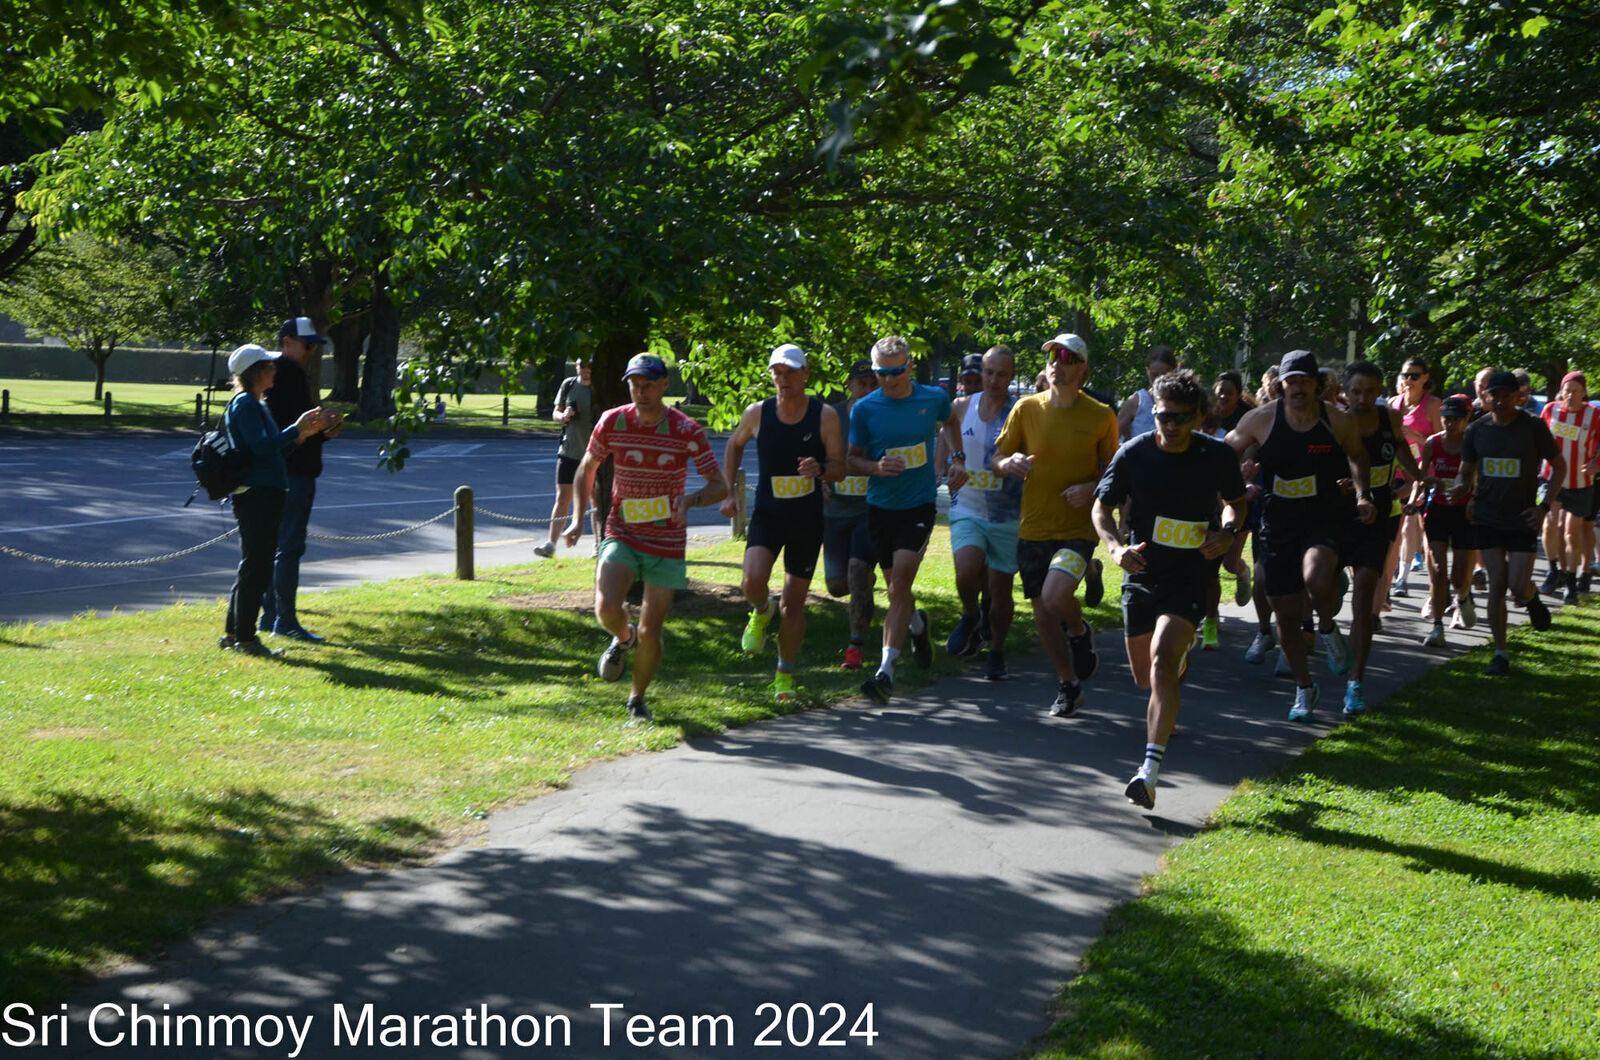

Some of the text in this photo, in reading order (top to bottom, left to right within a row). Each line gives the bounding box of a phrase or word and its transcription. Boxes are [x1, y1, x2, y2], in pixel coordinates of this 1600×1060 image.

[890, 446, 924, 465] 19
[1486, 459, 1517, 475] 610
[774, 477, 813, 496] 609
[837, 477, 867, 494] 613
[1275, 477, 1313, 496] 633
[626, 499, 667, 521] 630
[1156, 520, 1207, 546] 603
